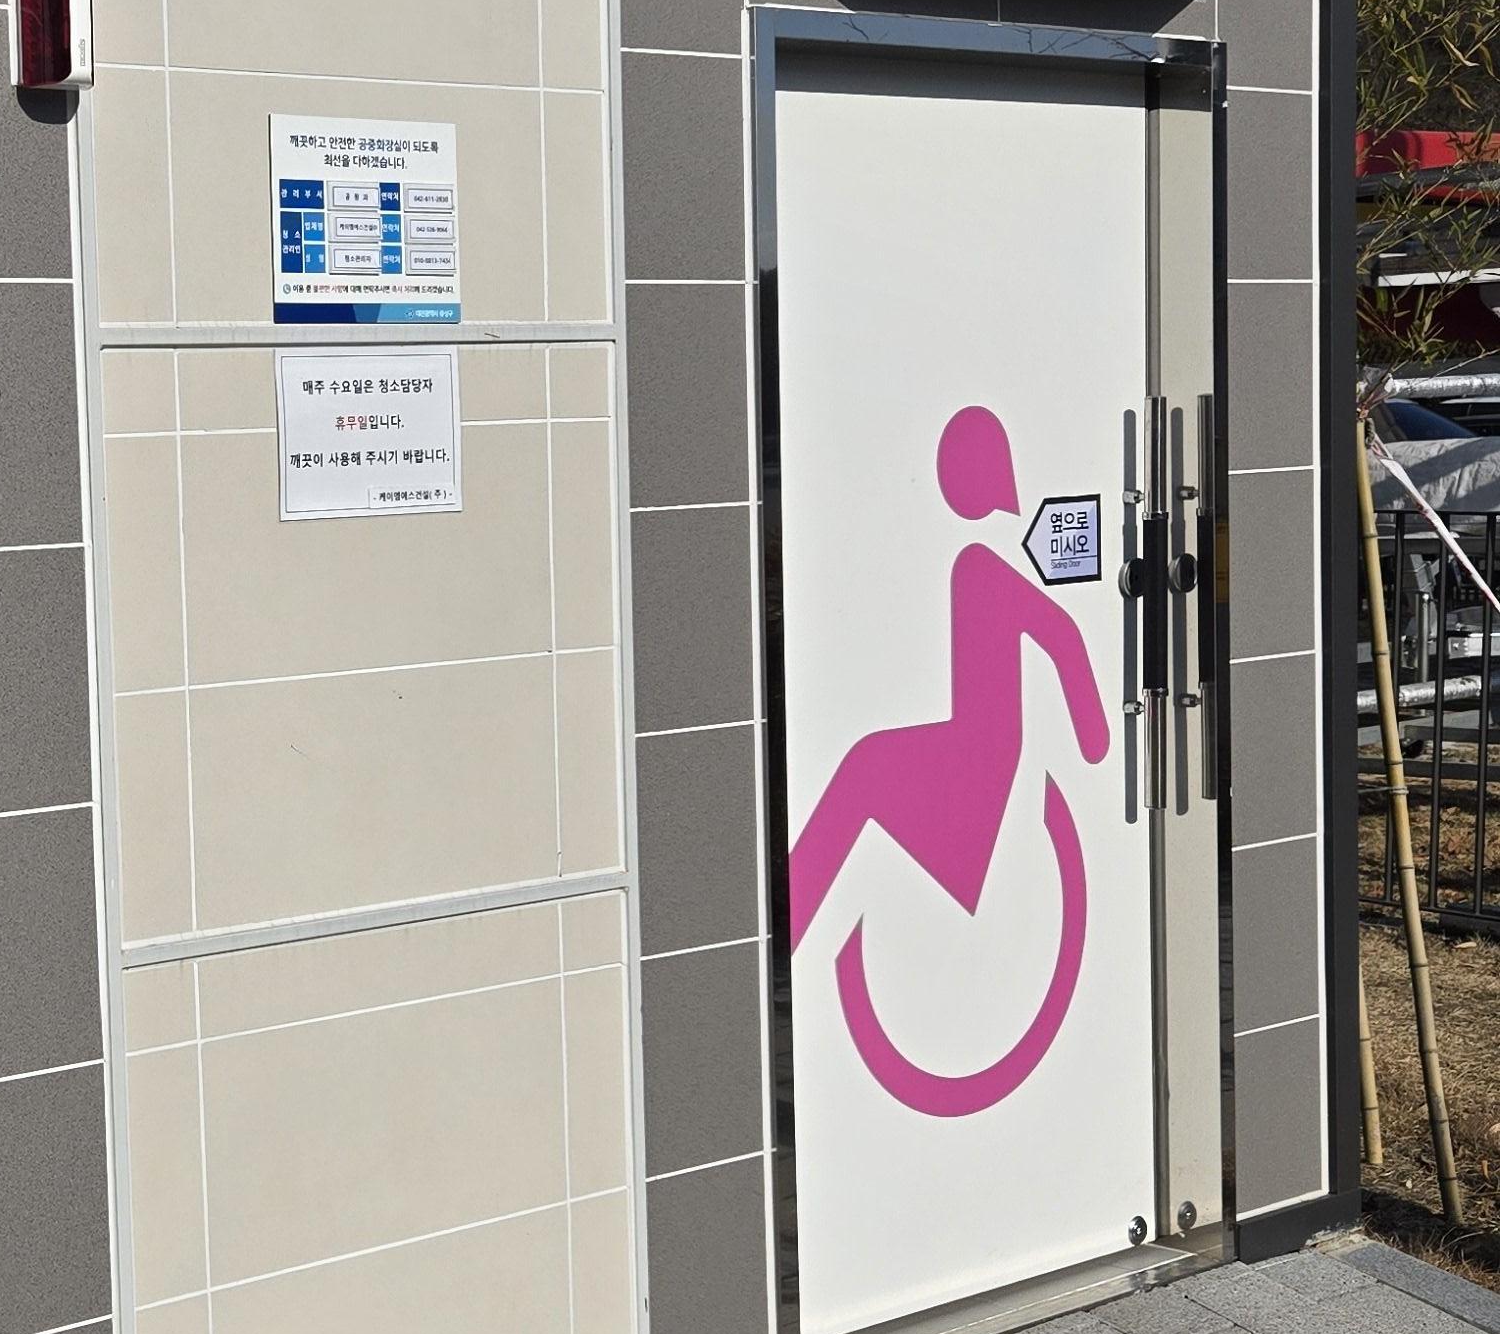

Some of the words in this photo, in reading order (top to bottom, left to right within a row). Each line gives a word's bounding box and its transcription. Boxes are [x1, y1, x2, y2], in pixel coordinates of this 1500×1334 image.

[290, 134, 327, 149] 깨끗하고
[329, 136, 356, 150] 안전한
[358, 137, 411, 153] 공중화장실이
[413, 140, 439, 154] 되도록
[324, 153, 350, 168] 최선을
[352, 155, 408, 170] 다하겠습니다.
[302, 380, 325, 395] 매주
[329, 379, 374, 395] 수요일은
[378, 378, 433, 394] 청소담당자
[335, 414, 405, 431] 휴무일입니다.
[290, 453, 323, 469] 깨끗이
[328, 451, 362, 467] 사용해
[365, 450, 398, 465] 주시기
[403, 448, 450, 465] 바랍니다.
[1050, 511, 1089, 534] 옆으로
[1050, 534, 1090, 557] 미시오
